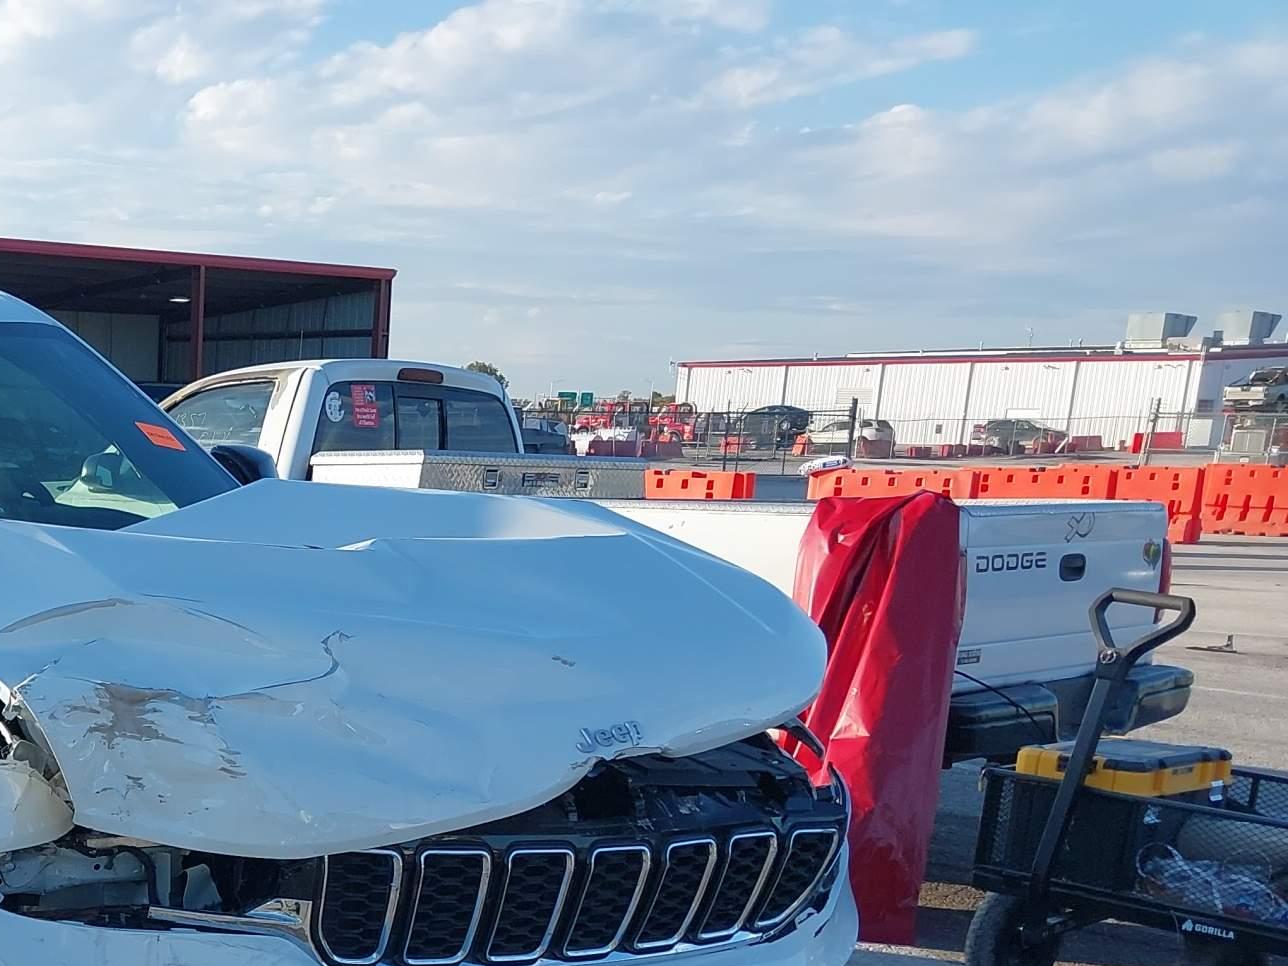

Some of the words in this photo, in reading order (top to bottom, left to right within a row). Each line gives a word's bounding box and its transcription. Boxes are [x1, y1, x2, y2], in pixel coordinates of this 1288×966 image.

[975, 552, 1047, 573] DODGE
[576, 720, 643, 753] Jeep
[1194, 923, 1234, 939] GORILLA
